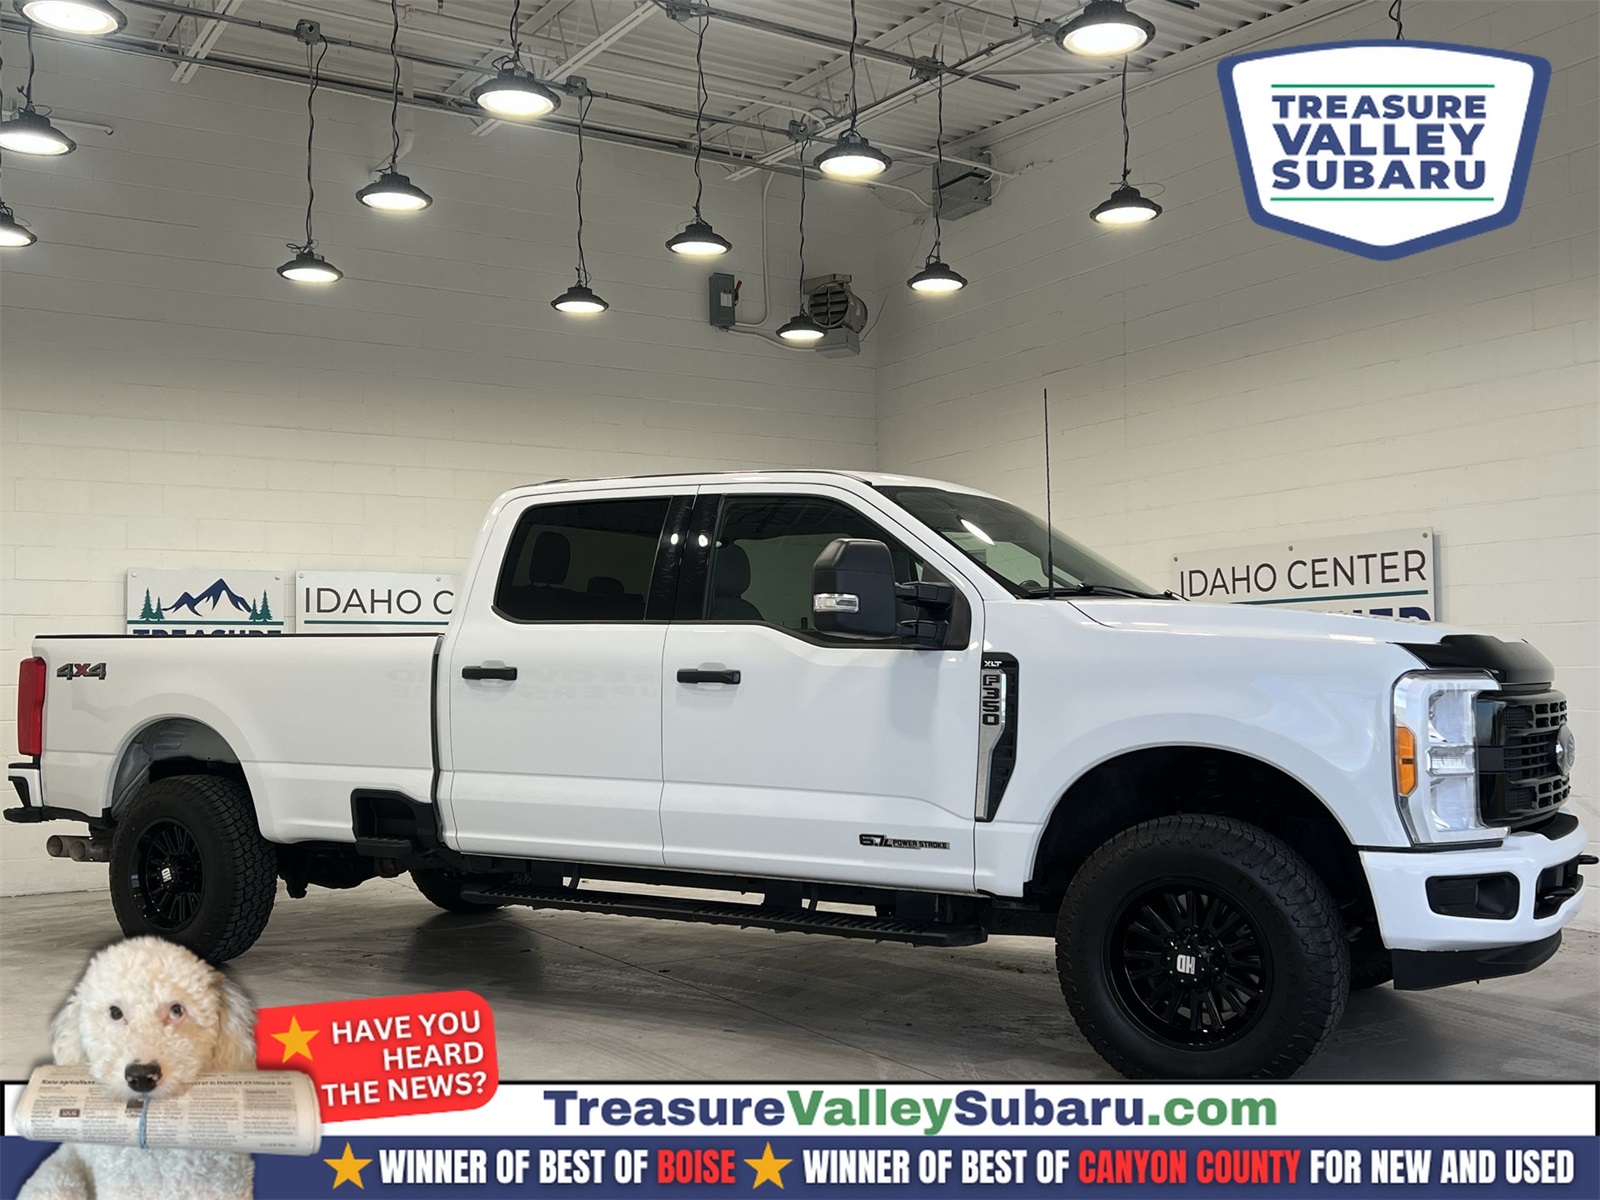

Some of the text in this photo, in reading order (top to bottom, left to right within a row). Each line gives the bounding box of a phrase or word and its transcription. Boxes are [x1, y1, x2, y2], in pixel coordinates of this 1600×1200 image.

[1180, 549, 1427, 598] IDAHO CENTER
[304, 587, 422, 615] IDAHO
[982, 674, 1000, 726] F350
[893, 839, 918, 848] POWER
[919, 840, 949, 849] STROKE
